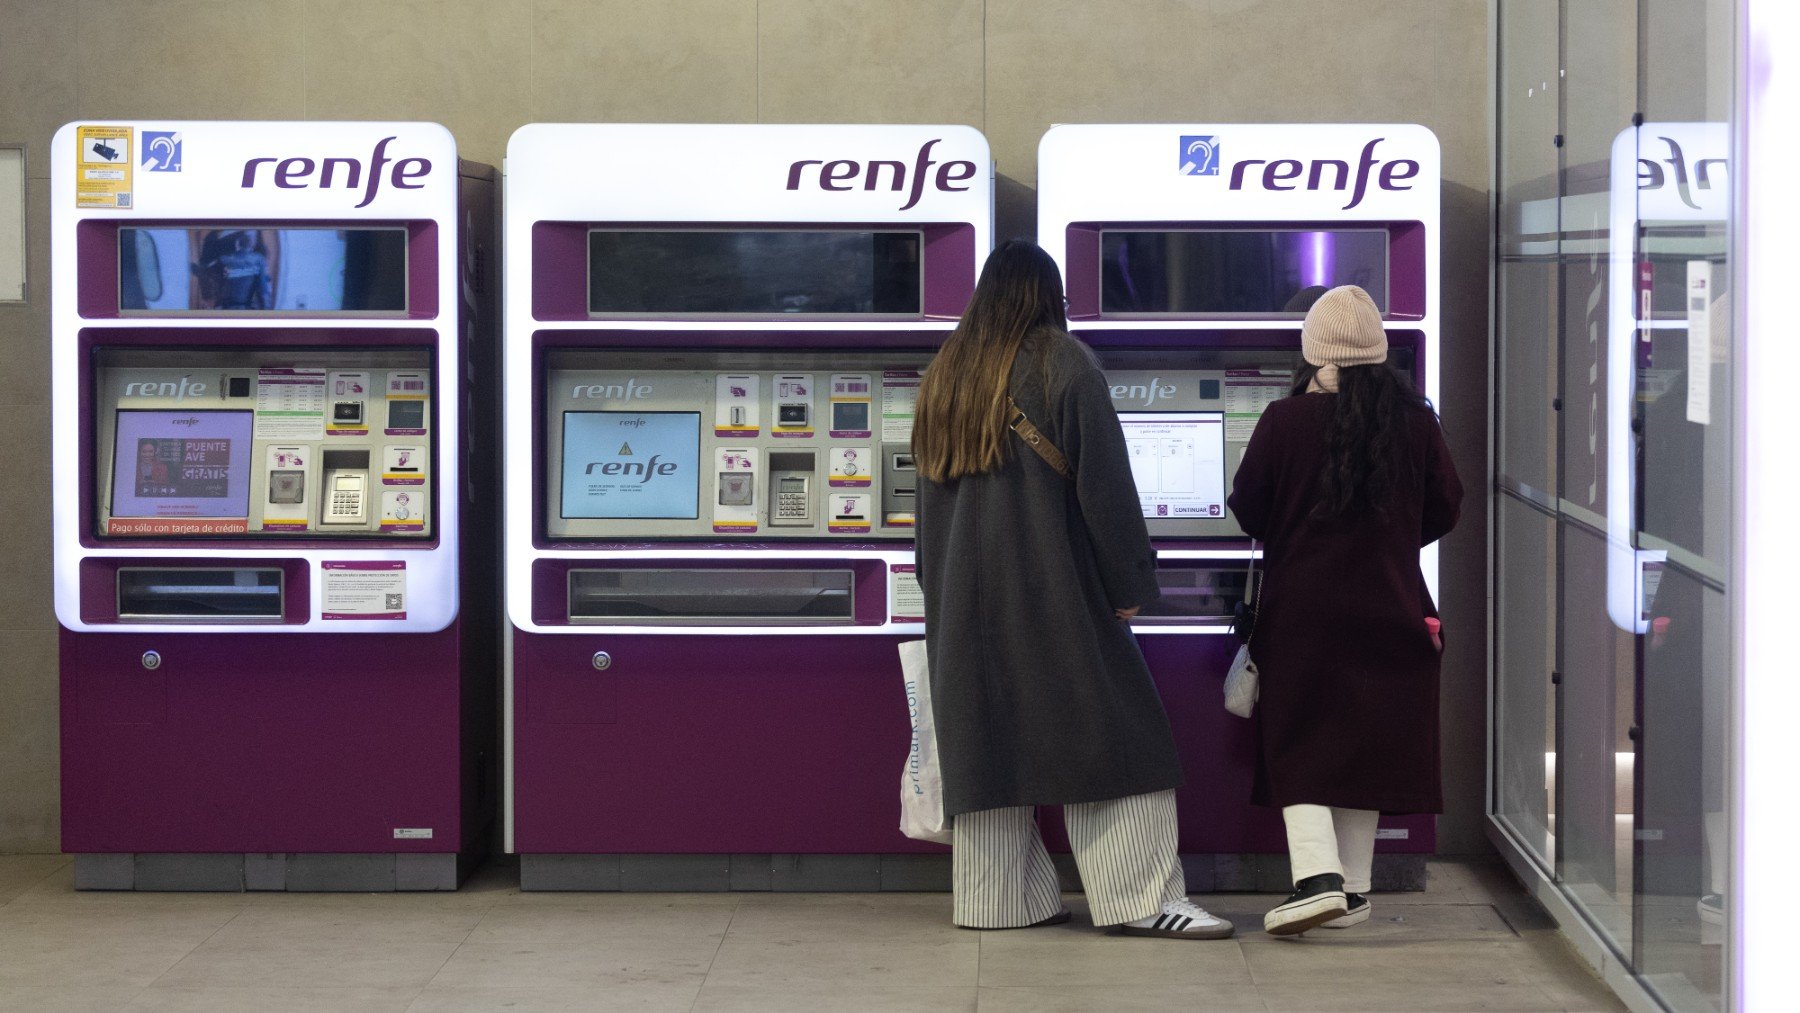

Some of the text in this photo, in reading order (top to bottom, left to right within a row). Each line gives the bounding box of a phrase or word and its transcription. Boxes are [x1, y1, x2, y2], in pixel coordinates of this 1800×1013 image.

[241, 136, 433, 209] renfe
[786, 138, 977, 211] renfe
[1229, 137, 1420, 211] renfe
[125, 374, 206, 403] renfe
[572, 378, 653, 405] renfe
[1109, 377, 1177, 407] enfe
[172, 416, 199, 427] renfe
[619, 418, 646, 428] renfe
[185, 452, 206, 461] AVE
[186, 442, 227, 451] PUENTE
[585, 454, 678, 484] renfe
[111, 523, 132, 534] Pago
[135, 523, 152, 532] sólo
[172, 524, 199, 534] tarjeta
[202, 523, 213, 533] de
[215, 523, 244, 533] crédito
